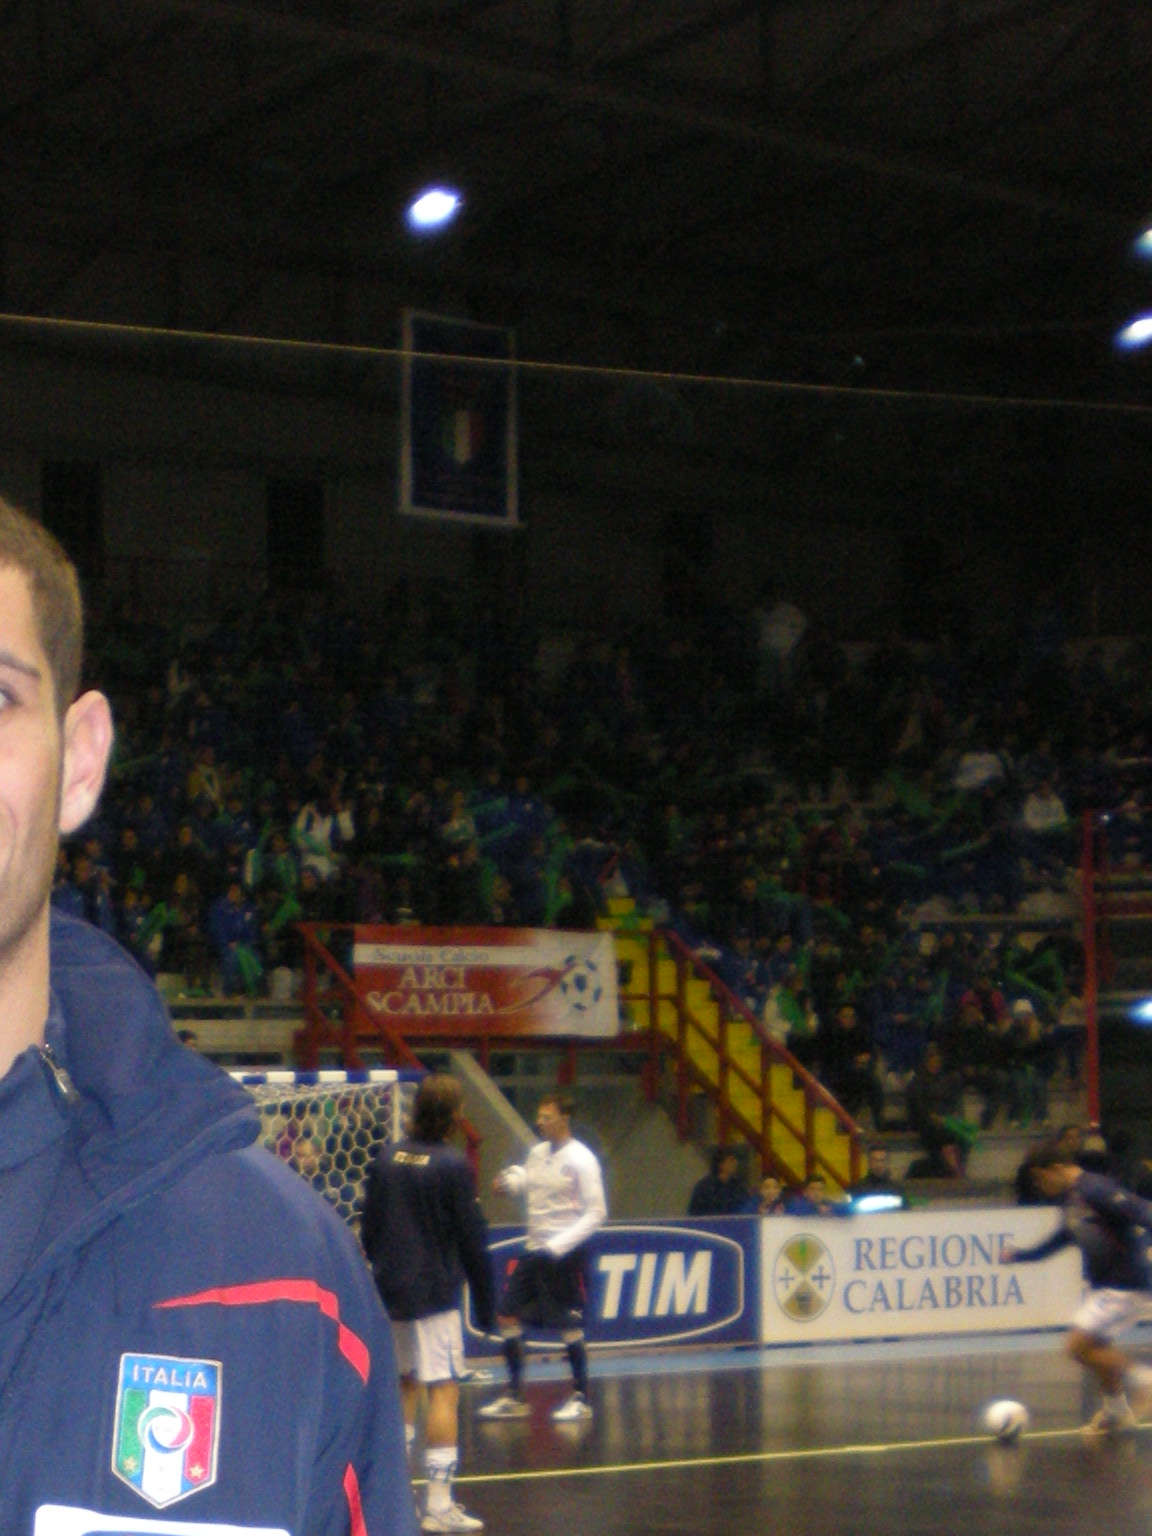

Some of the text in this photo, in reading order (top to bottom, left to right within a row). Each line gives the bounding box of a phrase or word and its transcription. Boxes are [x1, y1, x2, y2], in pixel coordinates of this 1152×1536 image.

[398, 966, 466, 989] ARCI
[365, 991, 495, 1015] SCAMPIA
[598, 1250, 712, 1319] TIM
[842, 1273, 1025, 1314] CALABRIA
[132, 1364, 208, 1390] ITALIA
